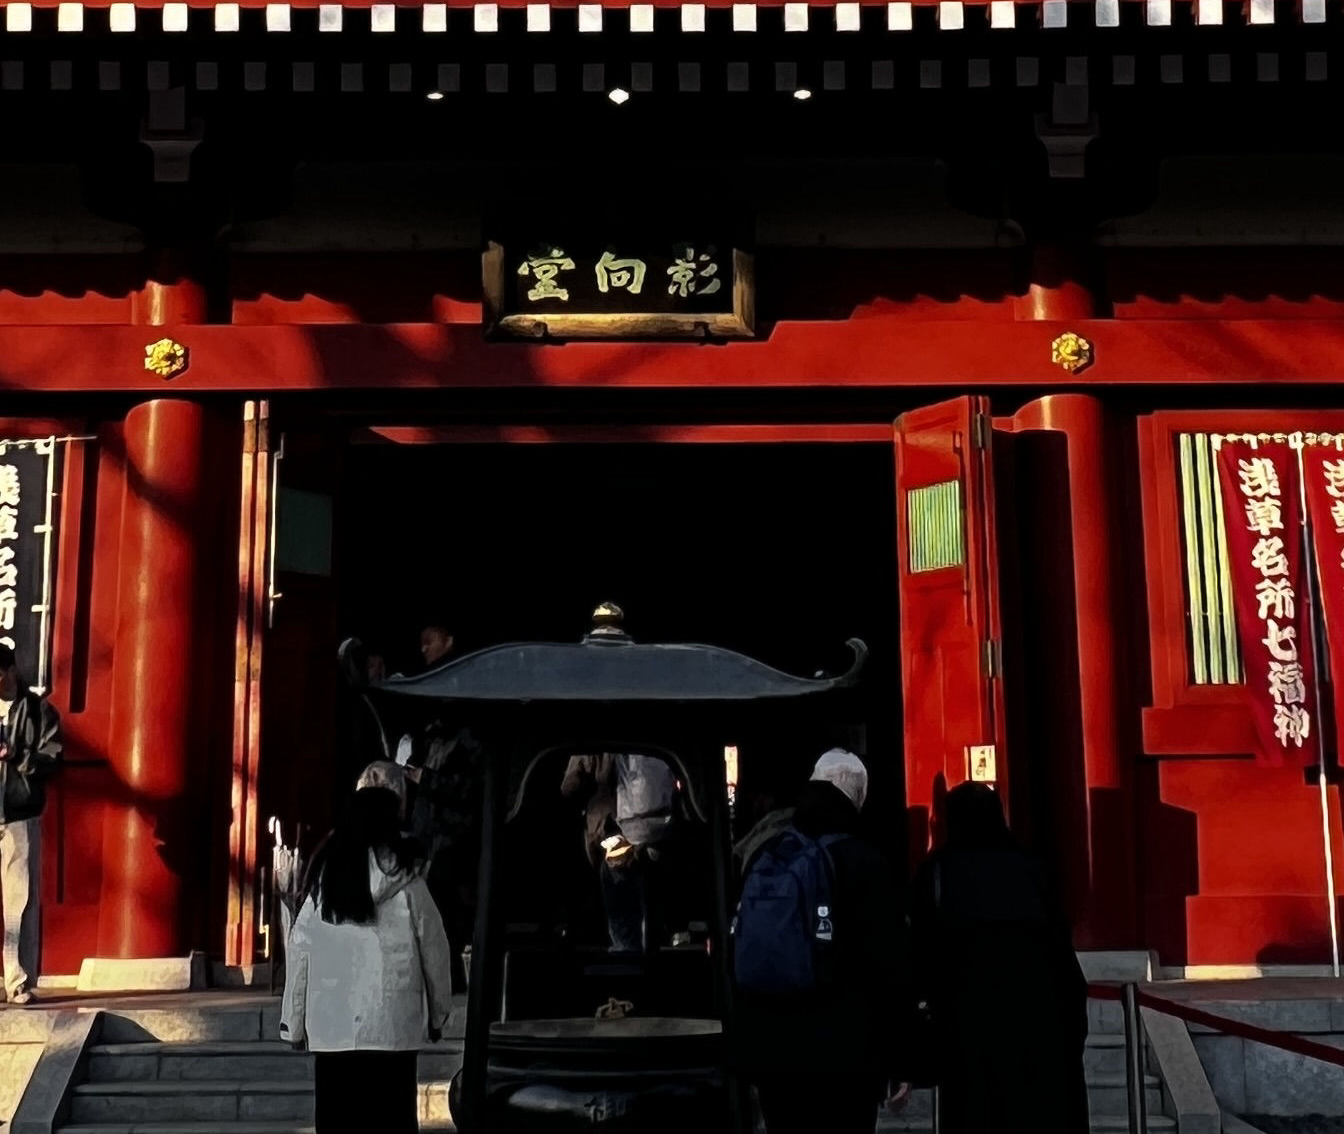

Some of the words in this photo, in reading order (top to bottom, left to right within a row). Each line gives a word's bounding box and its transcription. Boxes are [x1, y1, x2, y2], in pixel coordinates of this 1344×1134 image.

[1238, 457, 1311, 749] 浅草名所七福神
